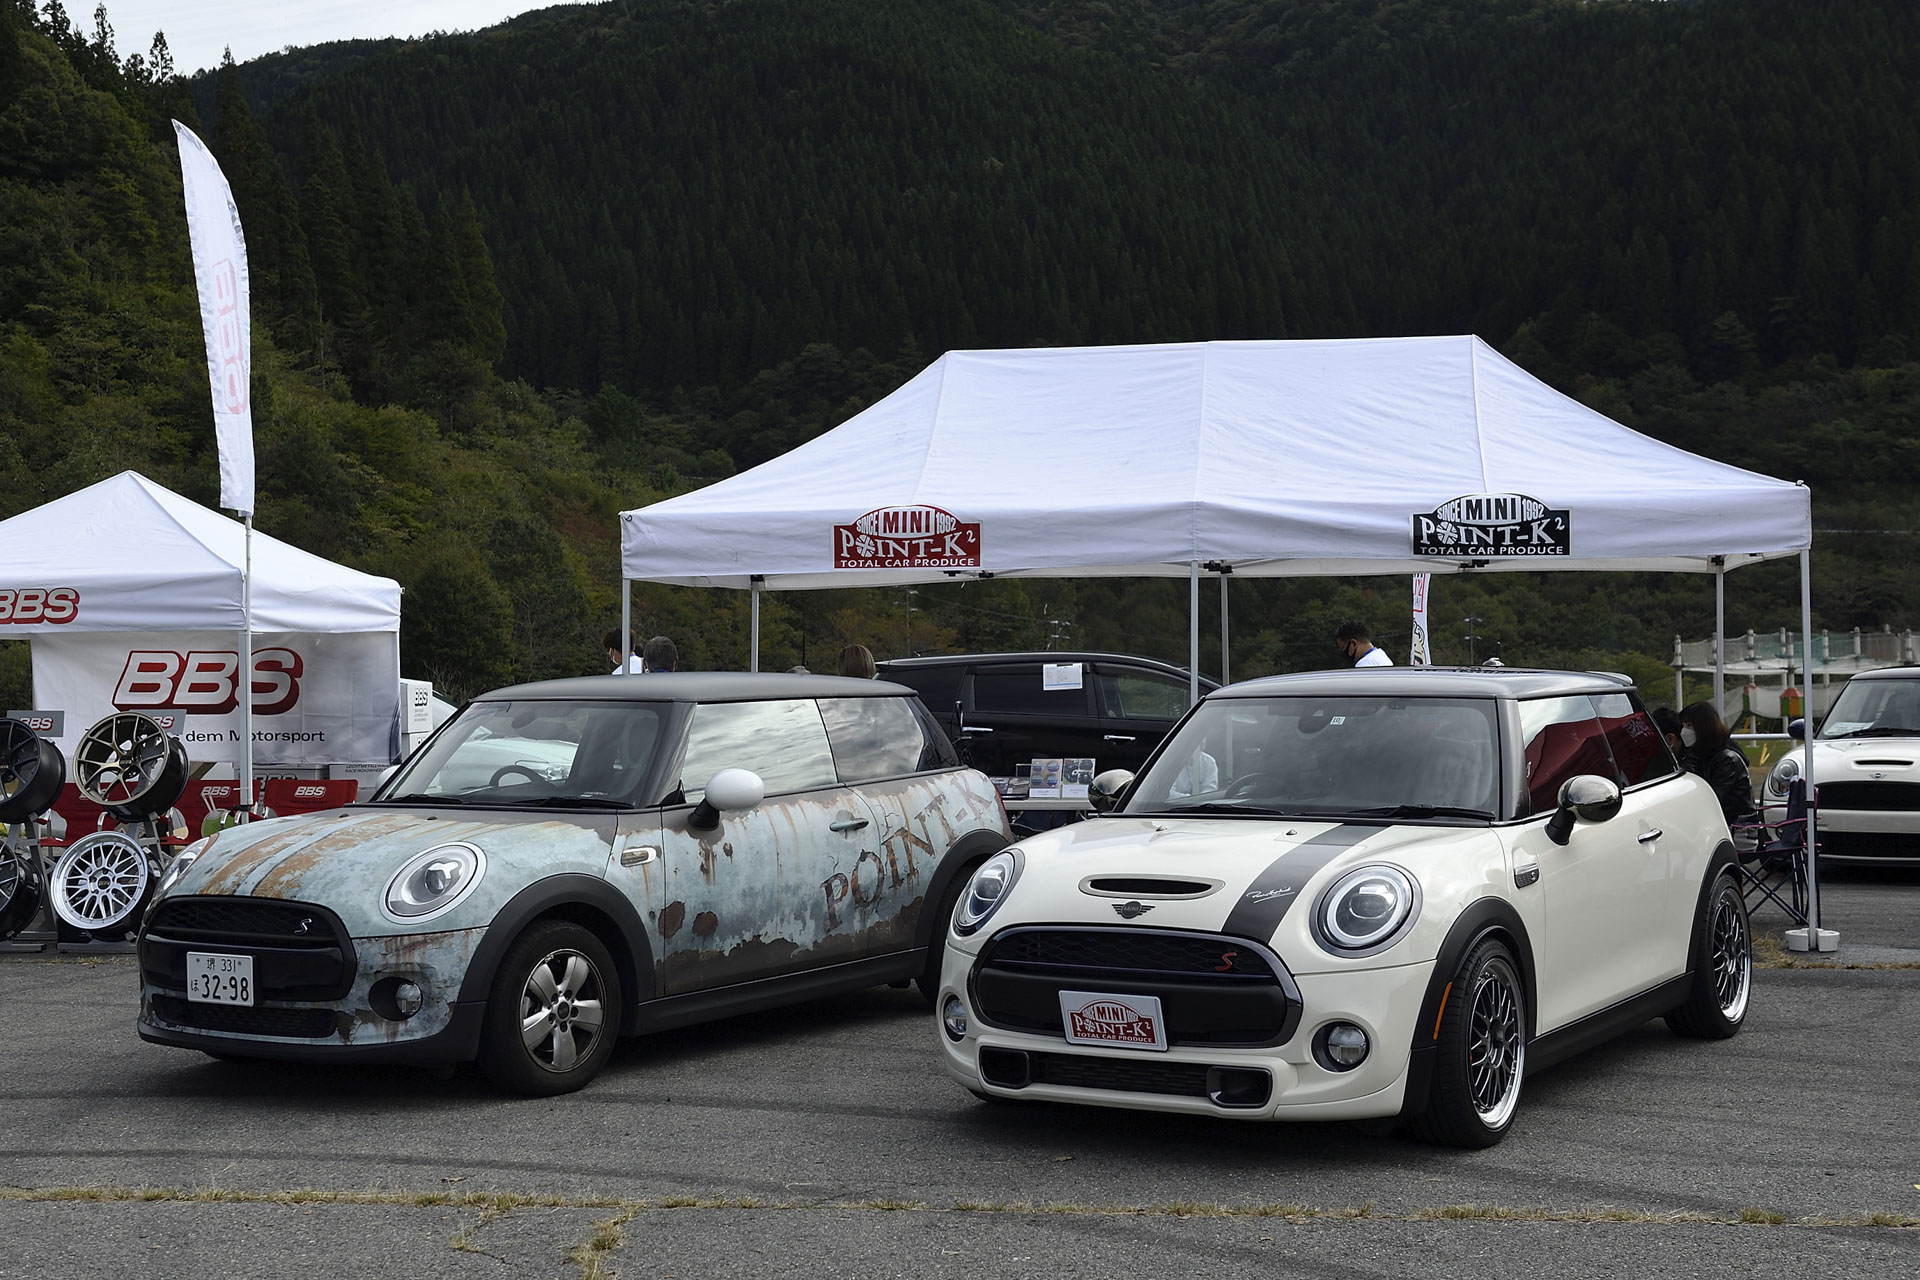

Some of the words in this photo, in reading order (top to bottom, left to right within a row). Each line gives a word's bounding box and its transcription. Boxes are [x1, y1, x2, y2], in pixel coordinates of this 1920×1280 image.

[1437, 499, 1461, 523] SINCE
[1465, 497, 1517, 521] MINI
[1521, 498, 1545, 521] 1992
[856, 511, 879, 536] SINCE
[883, 510, 931, 534] MINI
[936, 511, 957, 534] 1992
[1420, 546, 1464, 555] TOTAL
[1468, 546, 1495, 555] CAR
[1500, 546, 1563, 555] PRODUCE
[840, 559, 881, 568] TOTAL
[885, 559, 910, 567] CAR
[914, 558, 975, 567] PRODUCE
[112, 647, 304, 714] BBS
[185, 730, 223, 742] dem
[202, 786, 231, 797] BBS
[294, 786, 327, 798] BBS
[294, 918, 312, 935] S
[221, 958, 236, 972] 331
[1215, 952, 1237, 971] S
[201, 974, 249, 1001] 32-98
[1096, 1006, 1125, 1021] MINI
[1118, 1035, 1153, 1043] PRODUCE
